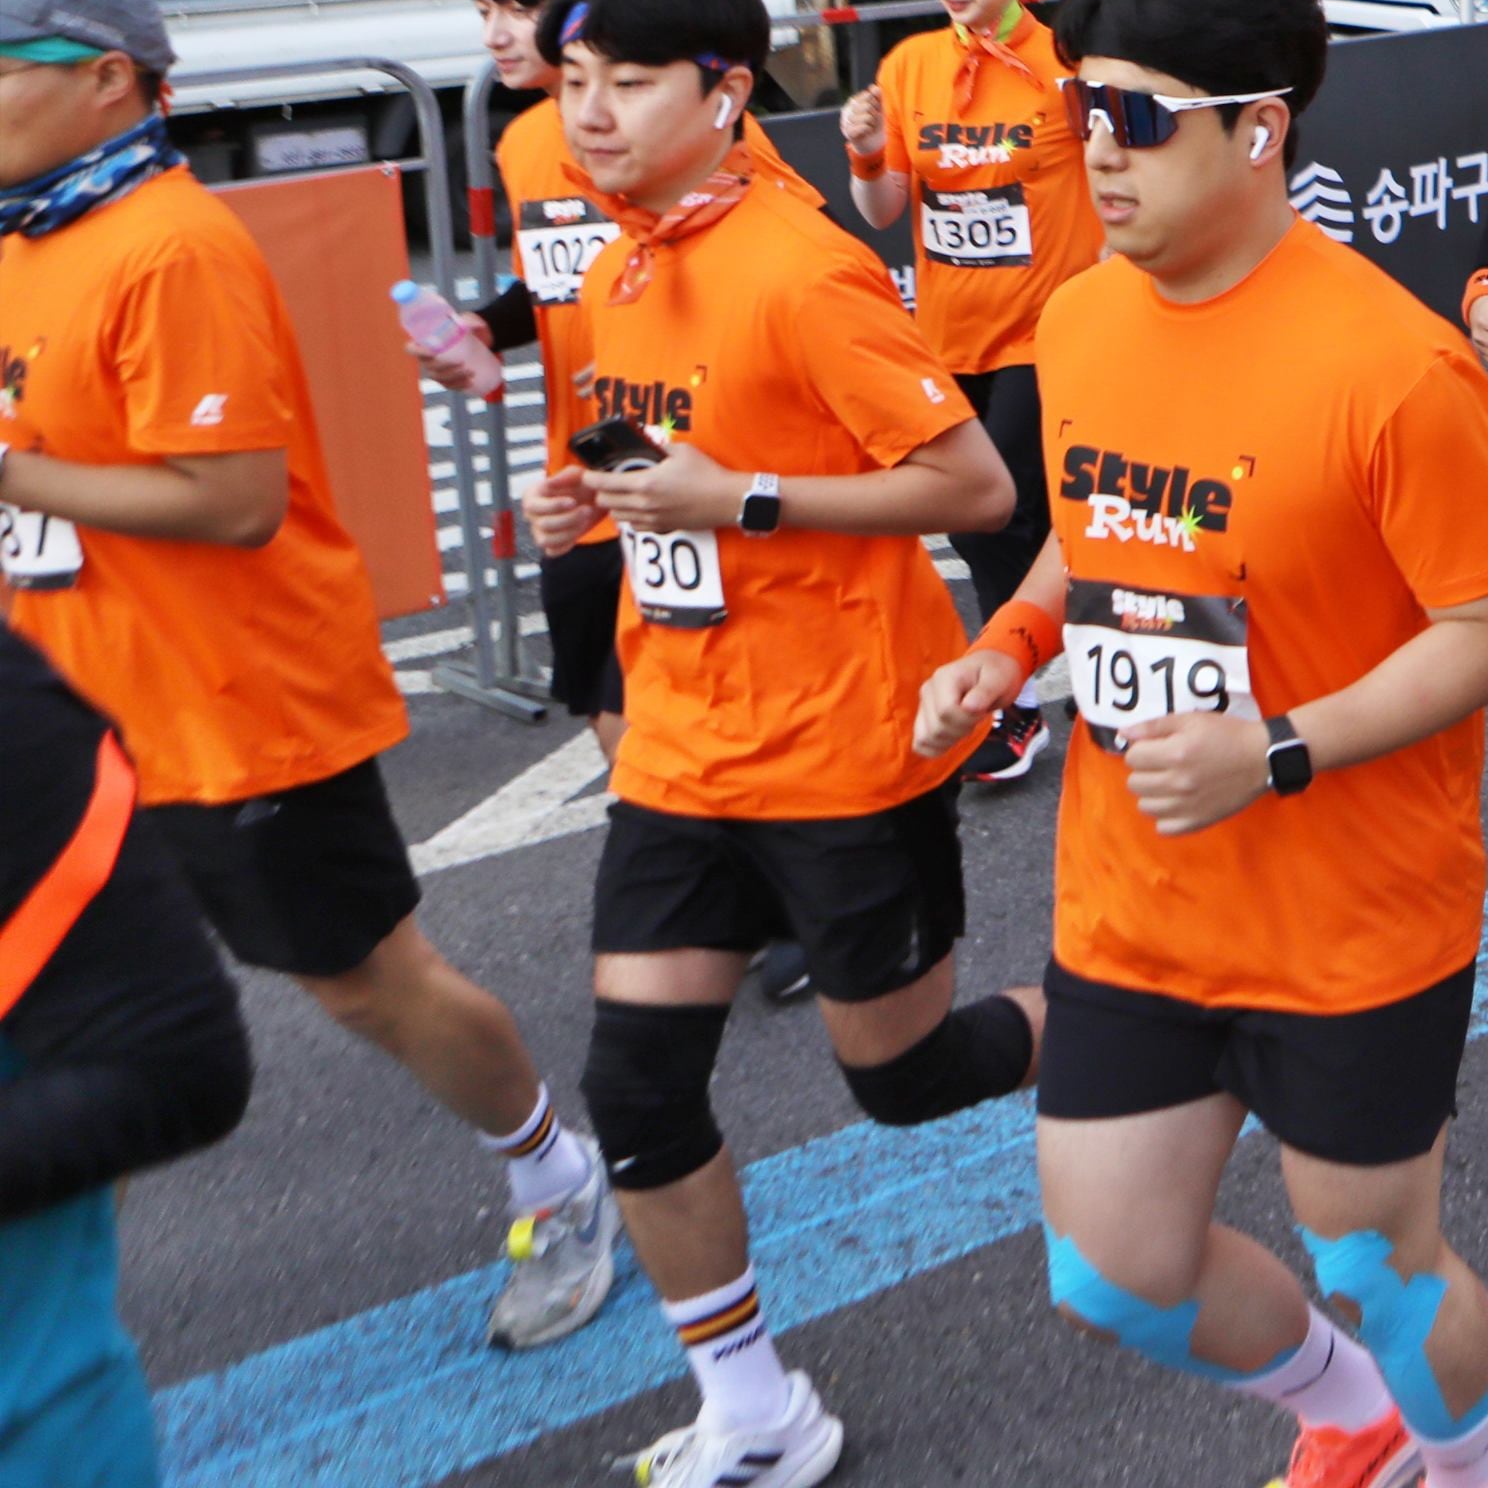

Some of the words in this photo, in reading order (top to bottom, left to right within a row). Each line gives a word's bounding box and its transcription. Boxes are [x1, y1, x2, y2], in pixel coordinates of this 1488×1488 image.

[918, 122, 1034, 151] Style
[938, 143, 1011, 169] Run
[928, 216, 1017, 250] 1305
[594, 375, 695, 433] Style
[1060, 444, 1233, 532] Style
[1085, 492, 1196, 552] Run
[1111, 588, 1186, 623] Style
[1085, 644, 1230, 716] 1919
